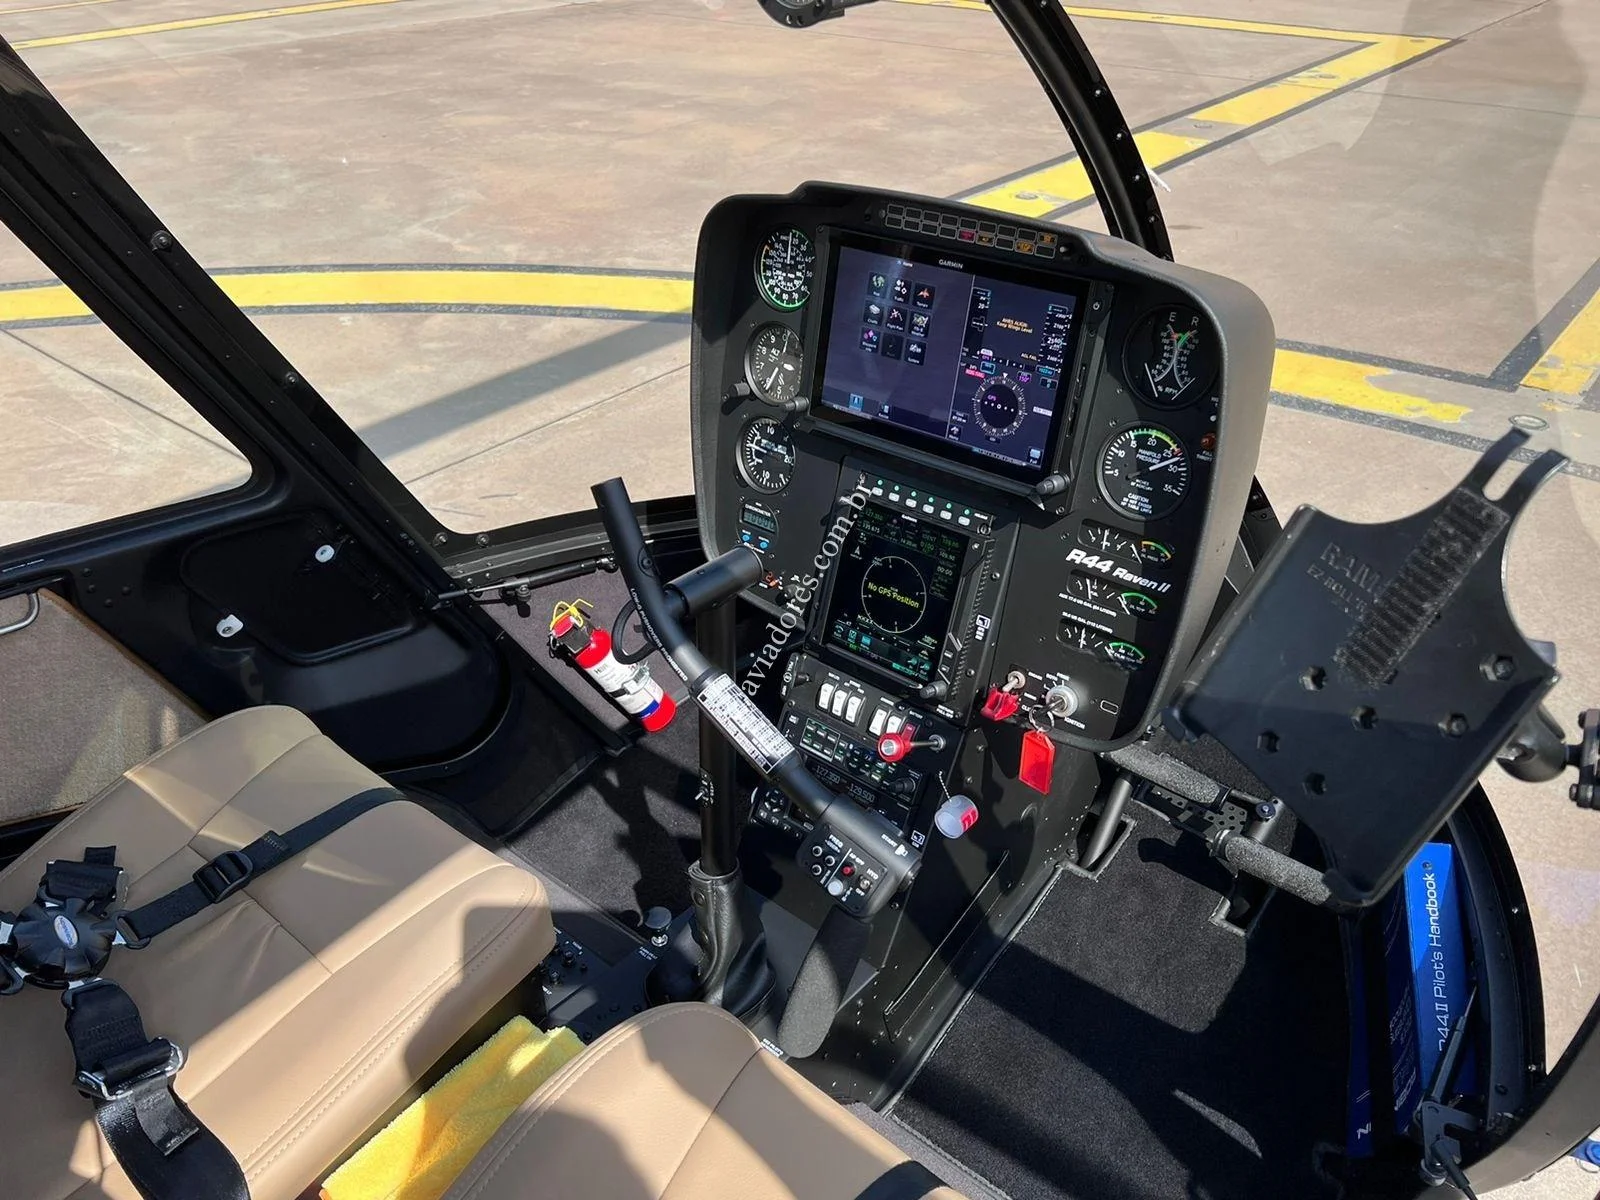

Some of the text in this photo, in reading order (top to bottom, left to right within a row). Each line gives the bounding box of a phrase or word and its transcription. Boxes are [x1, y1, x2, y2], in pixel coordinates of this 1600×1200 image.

[939, 258, 964, 270] GARMIN
[1169, 311, 1177, 321] E
[1191, 316, 1199, 326] R
[770, 335, 776, 344] 9
[761, 346, 767, 355] 8
[760, 361, 765, 370] 7
[777, 385, 782, 395] 5
[1164, 386, 1178, 394] RPM
[766, 425, 775, 435] 10
[1130, 440, 1137, 448] 15
[1147, 437, 1157, 447] 20
[1117, 449, 1126, 458] 10
[1135, 453, 1160, 464] PRESSURE
[1138, 449, 1161, 459] MANIFOLD
[1162, 449, 1173, 458] 25
[783, 454, 793, 464] 20
[1113, 469, 1119, 477] 5
[1167, 464, 1178, 473] 30
[762, 469, 771, 479] 10
[1162, 483, 1173, 493] 35
[1127, 492, 1150, 504] CAUTION
[1065, 548, 1171, 593] R44 Raven II
[867, 582, 920, 609] No GPS Position
[630, 588, 688, 682] LOW-G PUSHOVERS PROHIBITED
[1064, 716, 1086, 730] IGNITION
[849, 783, 876, 803] 129.500
[828, 834, 844, 848] FREQ
[881, 833, 898, 848] START
[866, 868, 879, 880] HYD
[1422, 872, 1442, 948] Handbook
[1430, 950, 1448, 1000] Pilot's
